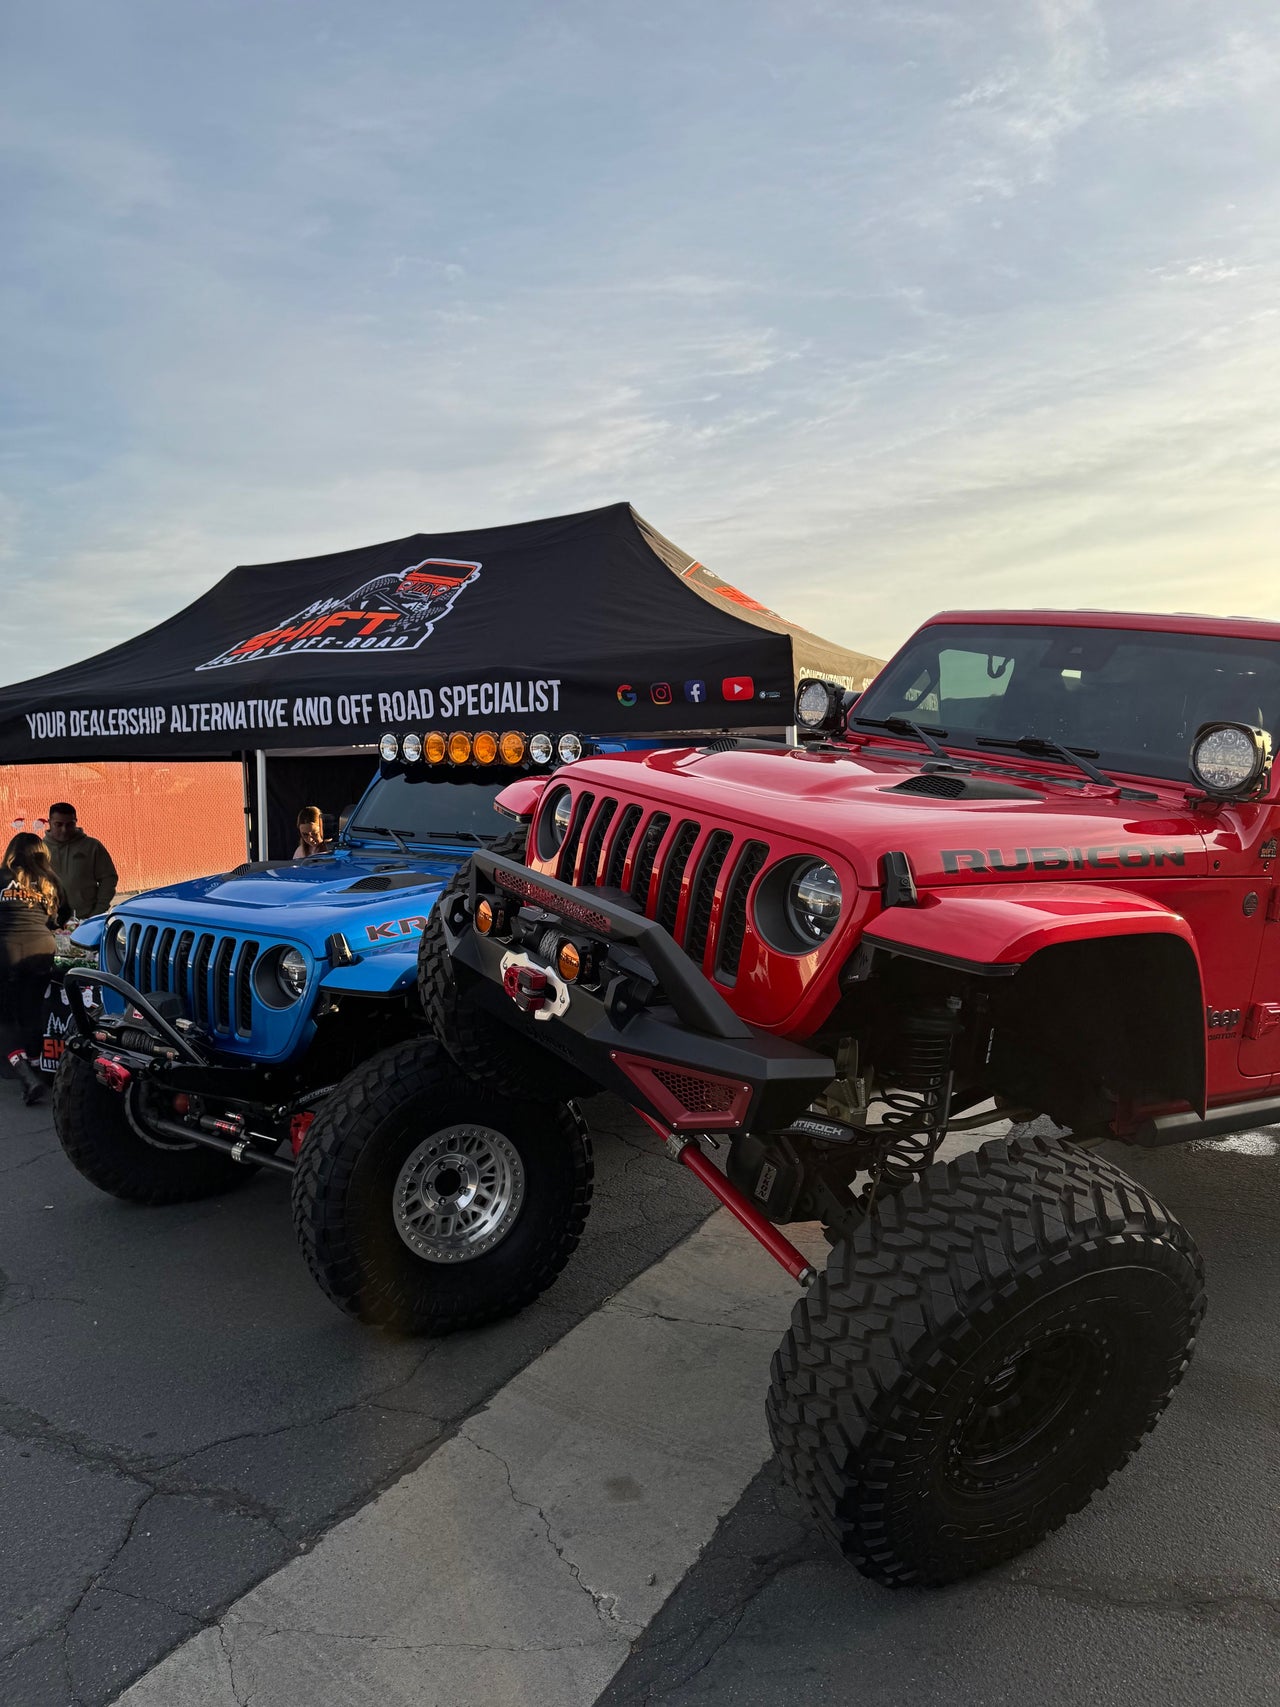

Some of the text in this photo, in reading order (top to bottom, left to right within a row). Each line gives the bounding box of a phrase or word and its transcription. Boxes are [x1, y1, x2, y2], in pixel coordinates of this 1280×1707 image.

[230, 611, 401, 655] SHIFT
[290, 637, 409, 650] OFF-ROAD
[25, 679, 561, 739] YOUR DEALERSHIP ALTERNATIVE AND OFF ROAD SPECIALIST
[941, 846, 1185, 874] RUBICON
[365, 915, 428, 942] KR
[790, 1119, 844, 1136] NTIROCK
